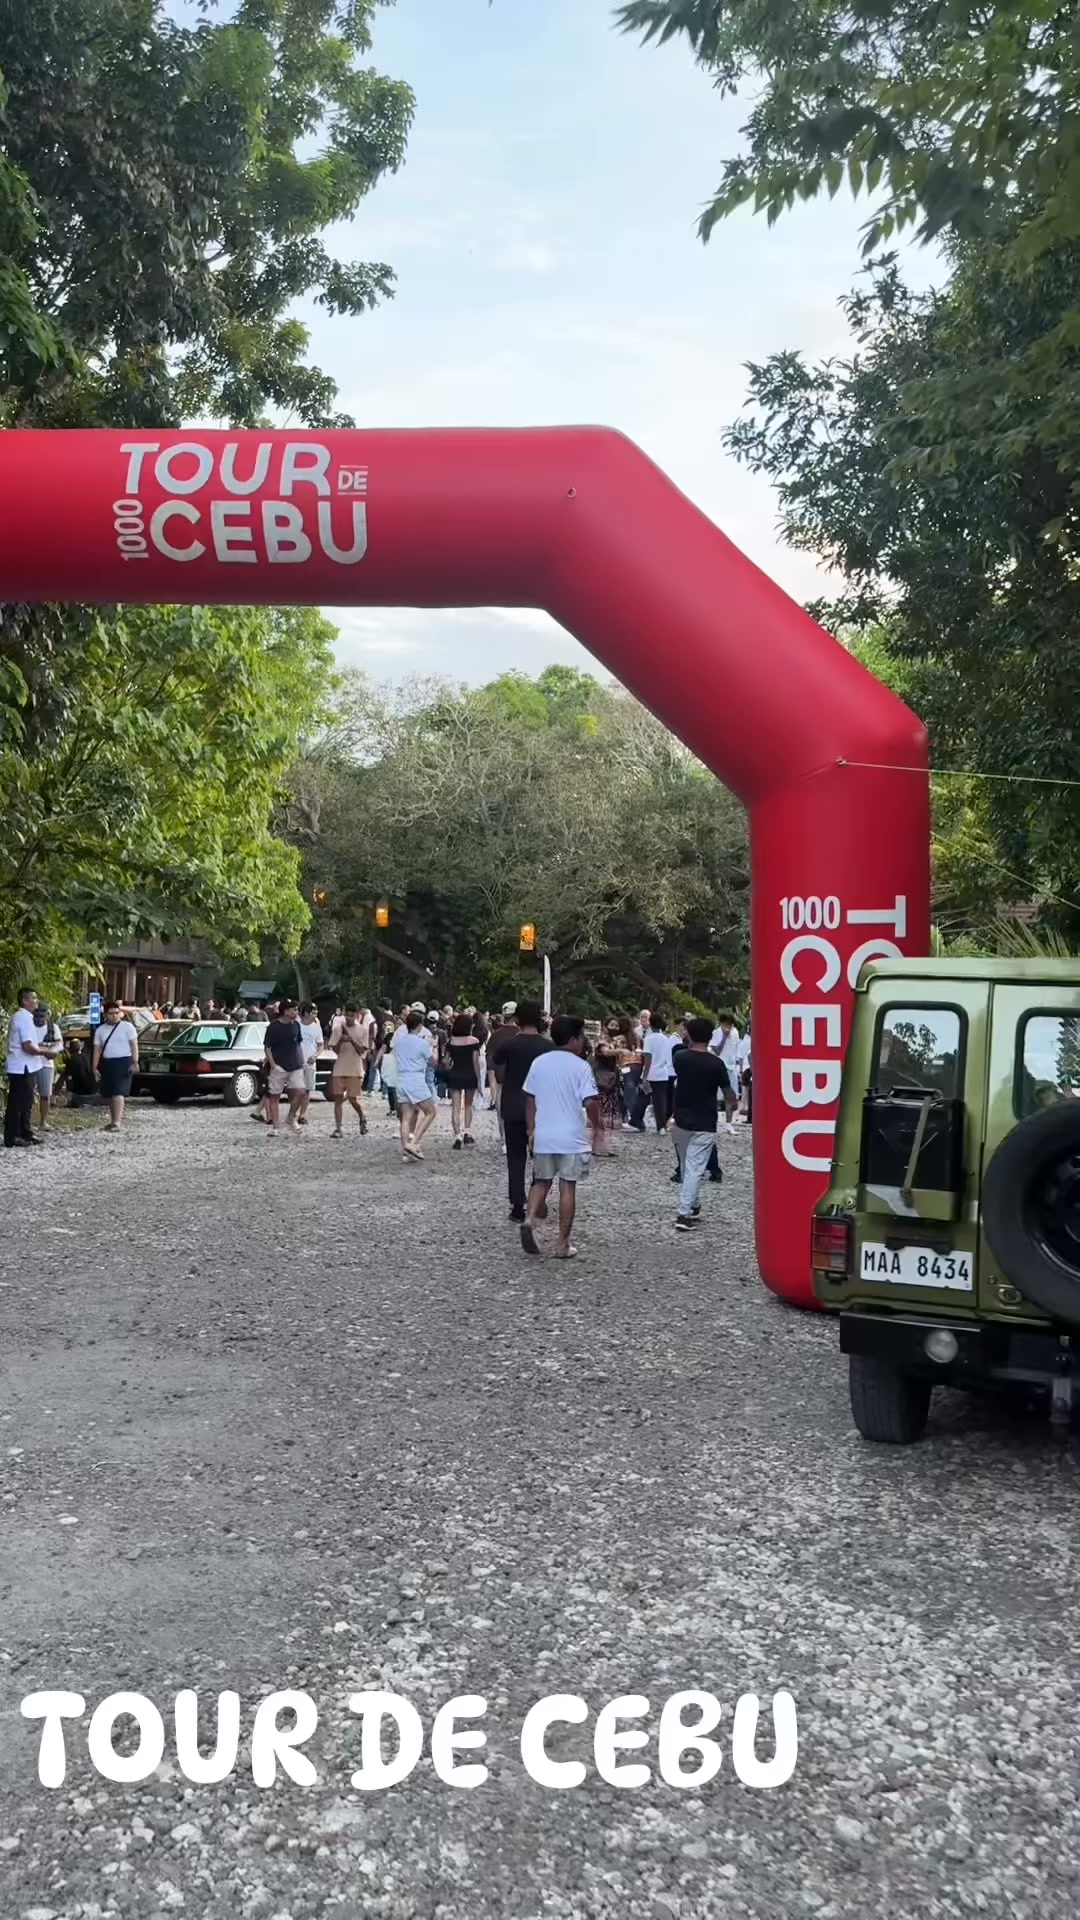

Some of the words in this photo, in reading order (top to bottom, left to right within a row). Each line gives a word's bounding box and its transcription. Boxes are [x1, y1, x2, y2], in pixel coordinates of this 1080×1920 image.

[119, 442, 331, 496] TOUR
[337, 469, 368, 491] DE
[112, 499, 149, 562] 1000
[150, 499, 368, 564] CEBU
[779, 895, 841, 930] 1000
[779, 934, 842, 1173] CEBU
[864, 1250, 901, 1275] MAA
[917, 1256, 969, 1281] 8434
